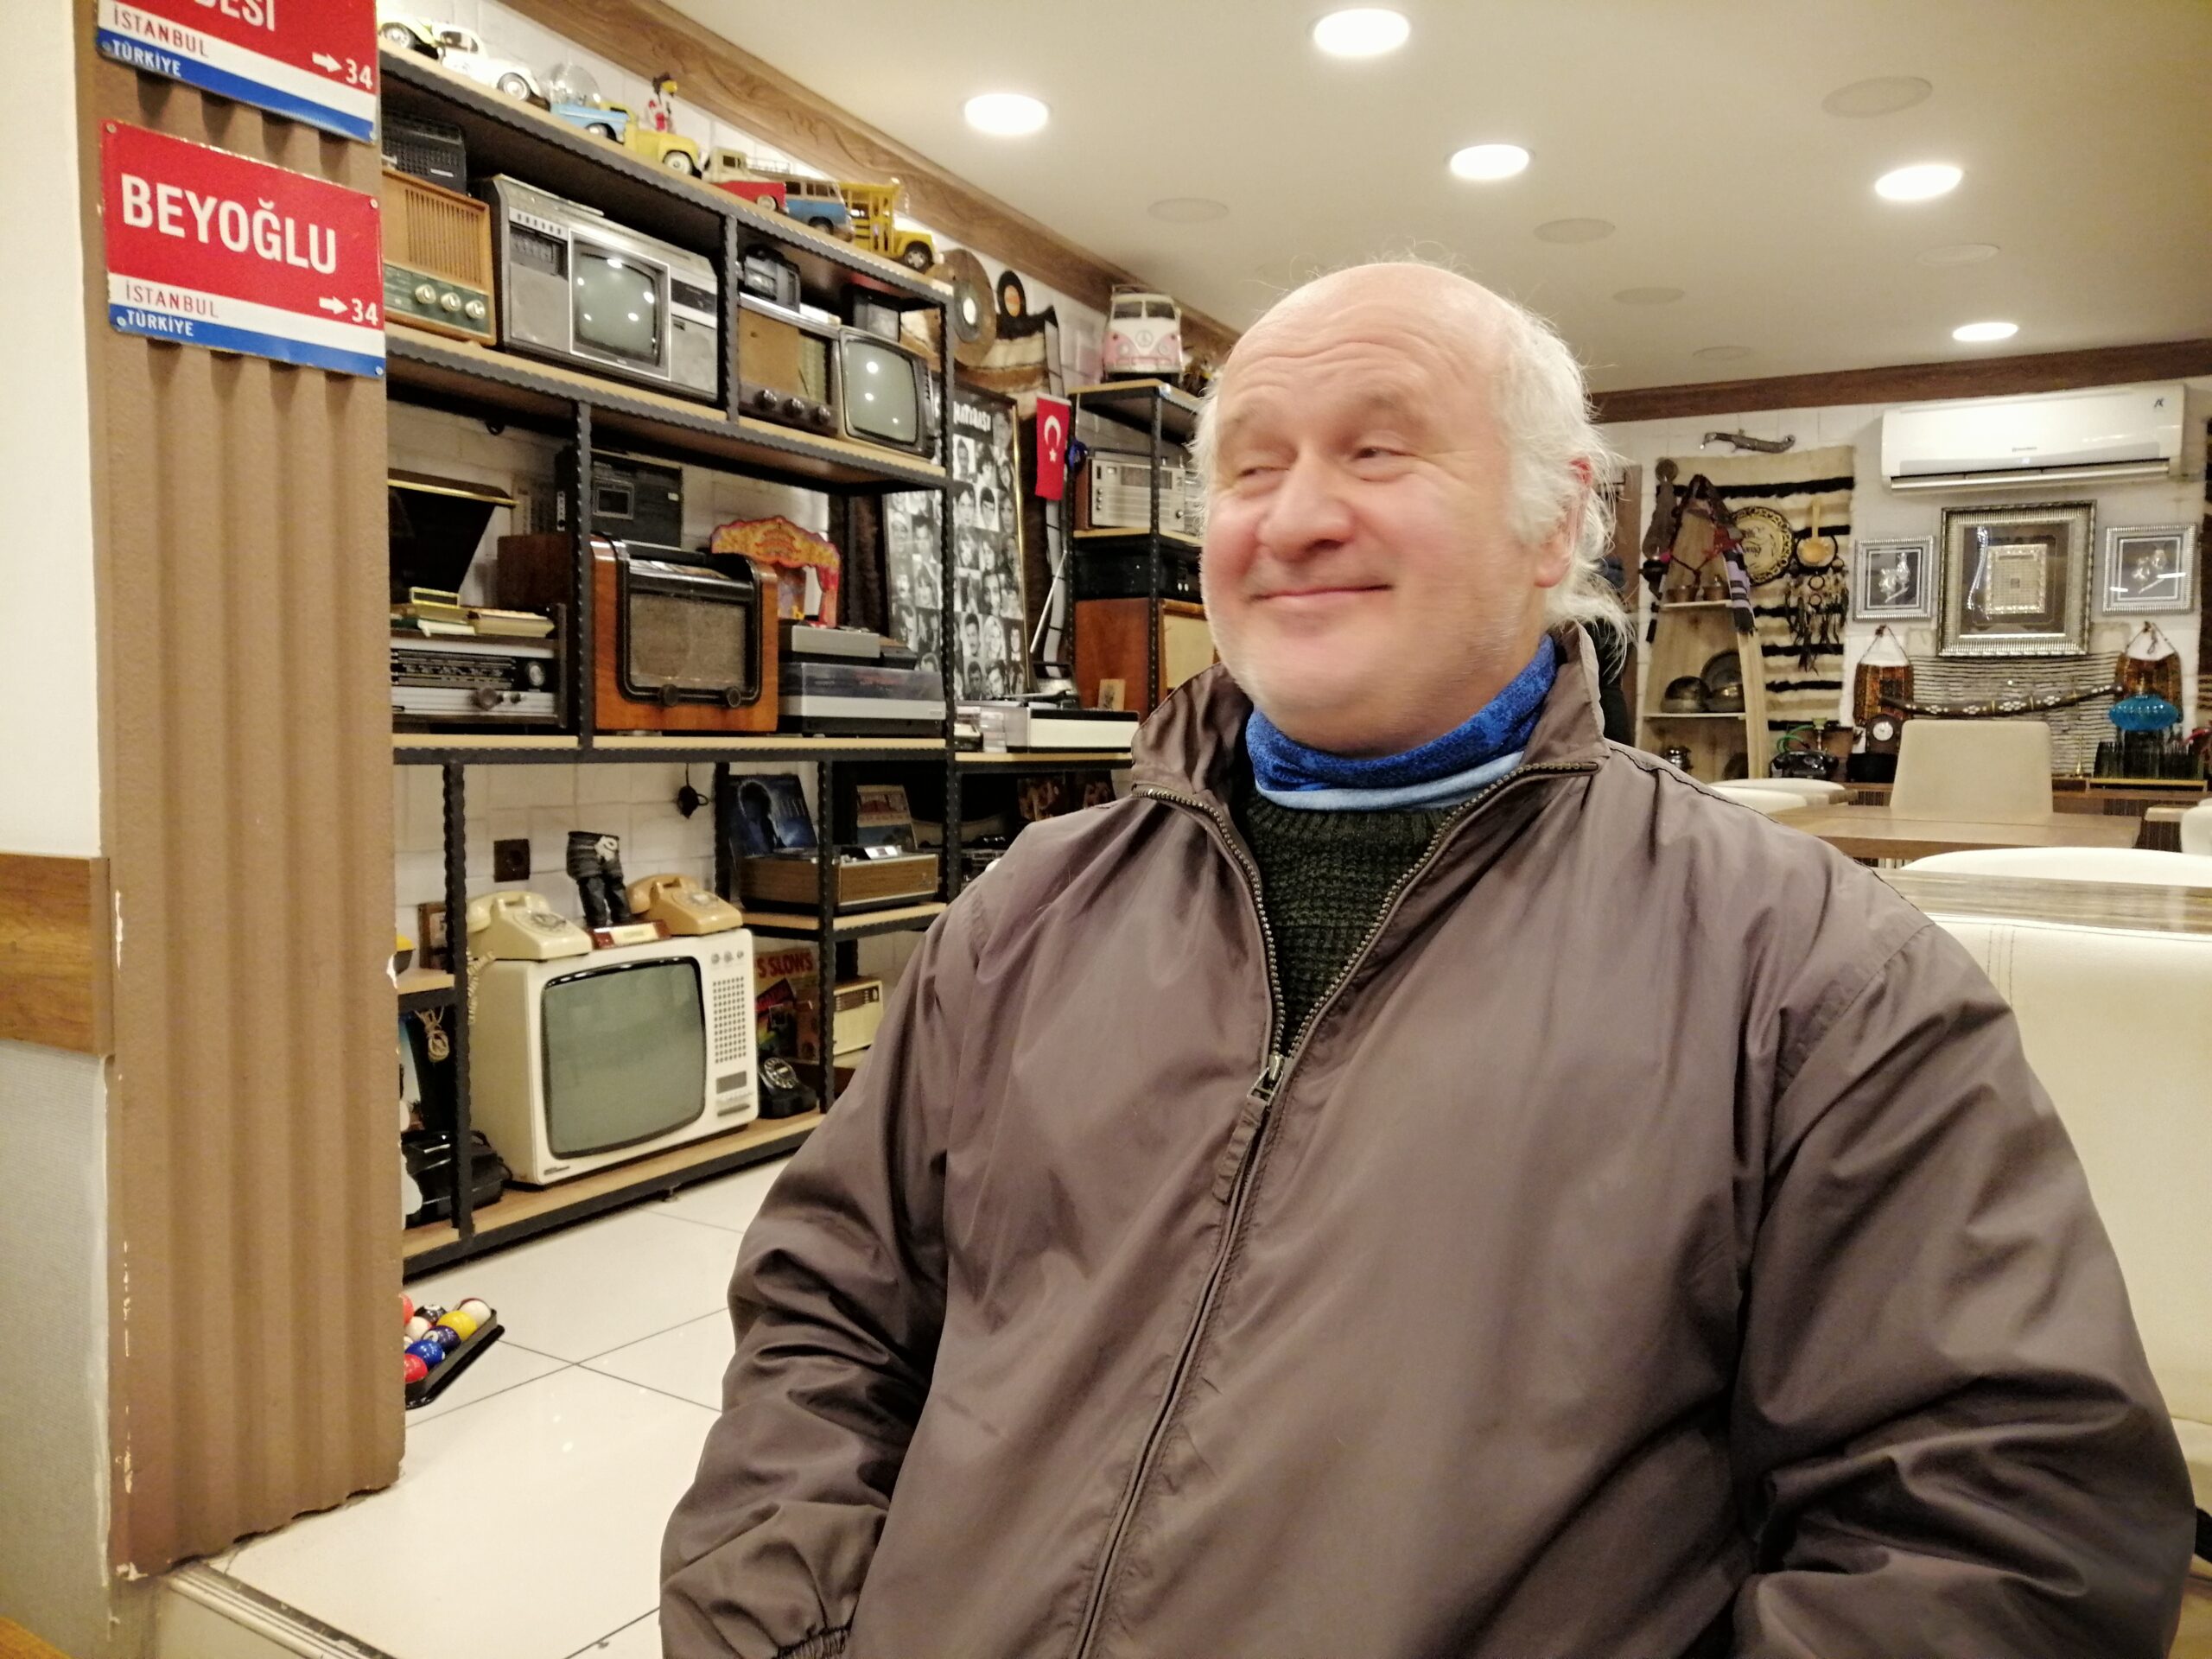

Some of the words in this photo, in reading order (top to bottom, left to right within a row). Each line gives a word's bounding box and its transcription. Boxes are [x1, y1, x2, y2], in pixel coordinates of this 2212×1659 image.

[112, 39, 181, 78] TÜRKİYE
[346, 59, 373, 89] 34
[121, 174, 337, 275] BEYOĞLU
[125, 280, 219, 318] İSTANBUL
[351, 298, 378, 326] 34
[126, 309, 194, 336] TÜRKİYE
